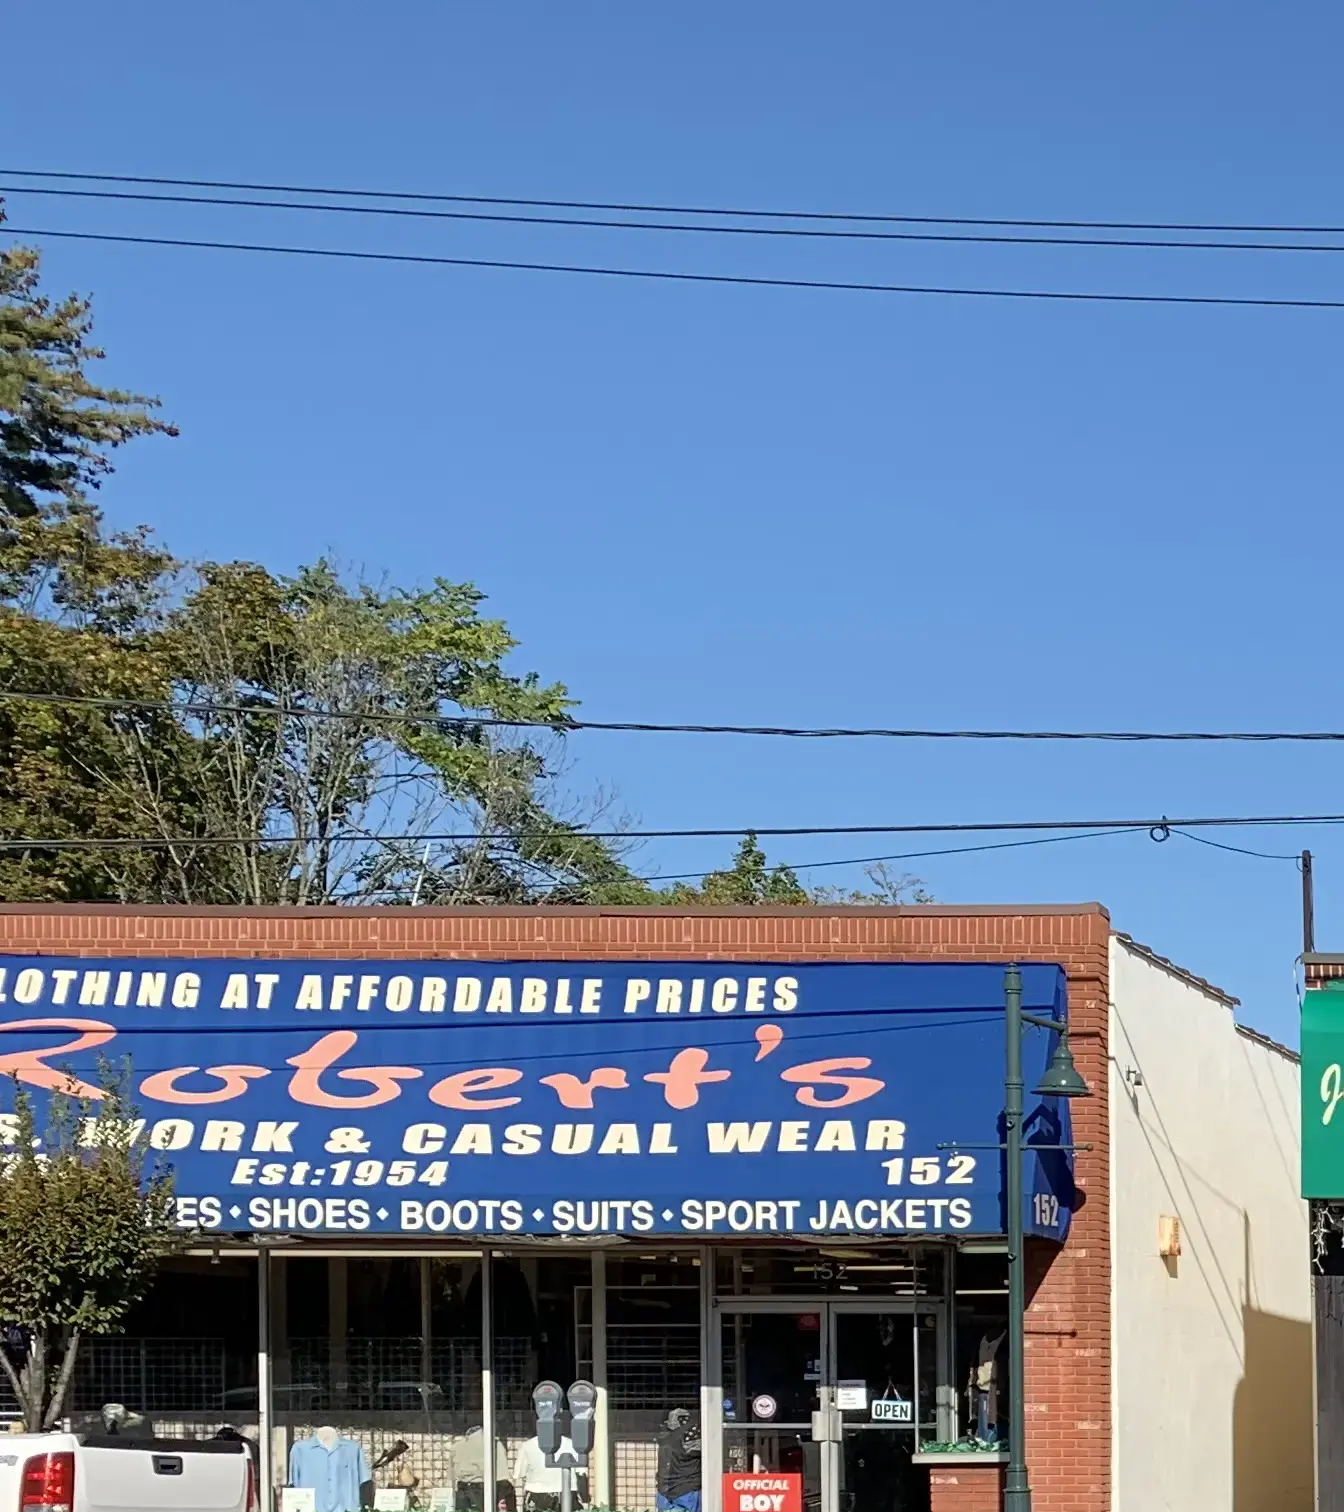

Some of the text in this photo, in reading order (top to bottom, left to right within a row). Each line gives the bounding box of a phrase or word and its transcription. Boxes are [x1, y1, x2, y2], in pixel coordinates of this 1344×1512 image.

[220, 973, 279, 1011] AT
[295, 974, 603, 1014] AFFORDABLE
[623, 976, 799, 1014] PRICES
[0, 1018, 886, 1110] Robert's
[325, 1123, 371, 1153] &
[402, 1122, 679, 1155] CASUAL
[707, 1119, 906, 1153] WEAR
[230, 1158, 450, 1187] Est:1954
[880, 1157, 977, 1186] 152
[248, 1198, 370, 1229] SHOES
[400, 1199, 522, 1231] BOOTS
[552, 1200, 655, 1231] SUITS
[681, 1199, 800, 1231] SPORT
[809, 1198, 972, 1229] JACKETS
[1033, 1193, 1059, 1228] 152
[812, 1263, 848, 1280] 152
[874, 1403, 909, 1419] OPEN
[733, 1479, 790, 1491] OFFICIAL
[739, 1494, 785, 1512] BOY
